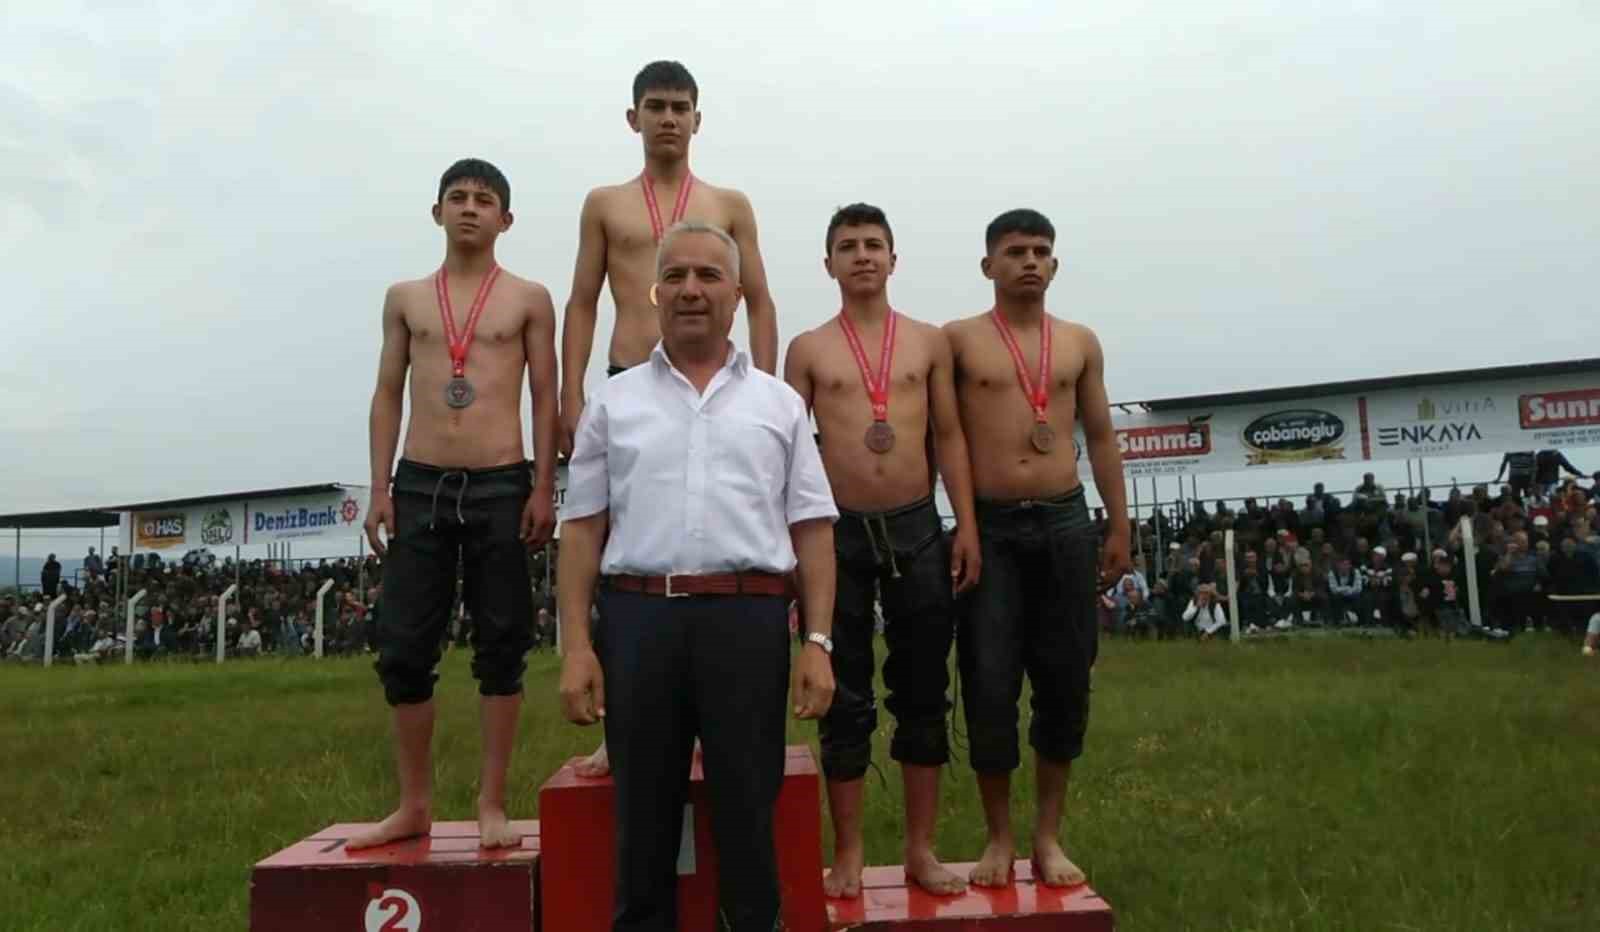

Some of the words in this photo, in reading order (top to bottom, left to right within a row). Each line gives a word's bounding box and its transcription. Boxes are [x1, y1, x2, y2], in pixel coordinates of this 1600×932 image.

[1117, 431, 1203, 453] Sunma
[1379, 422, 1483, 446] ENKAYA
[254, 506, 337, 532] DenizBank
[378, 896, 409, 932] 2
